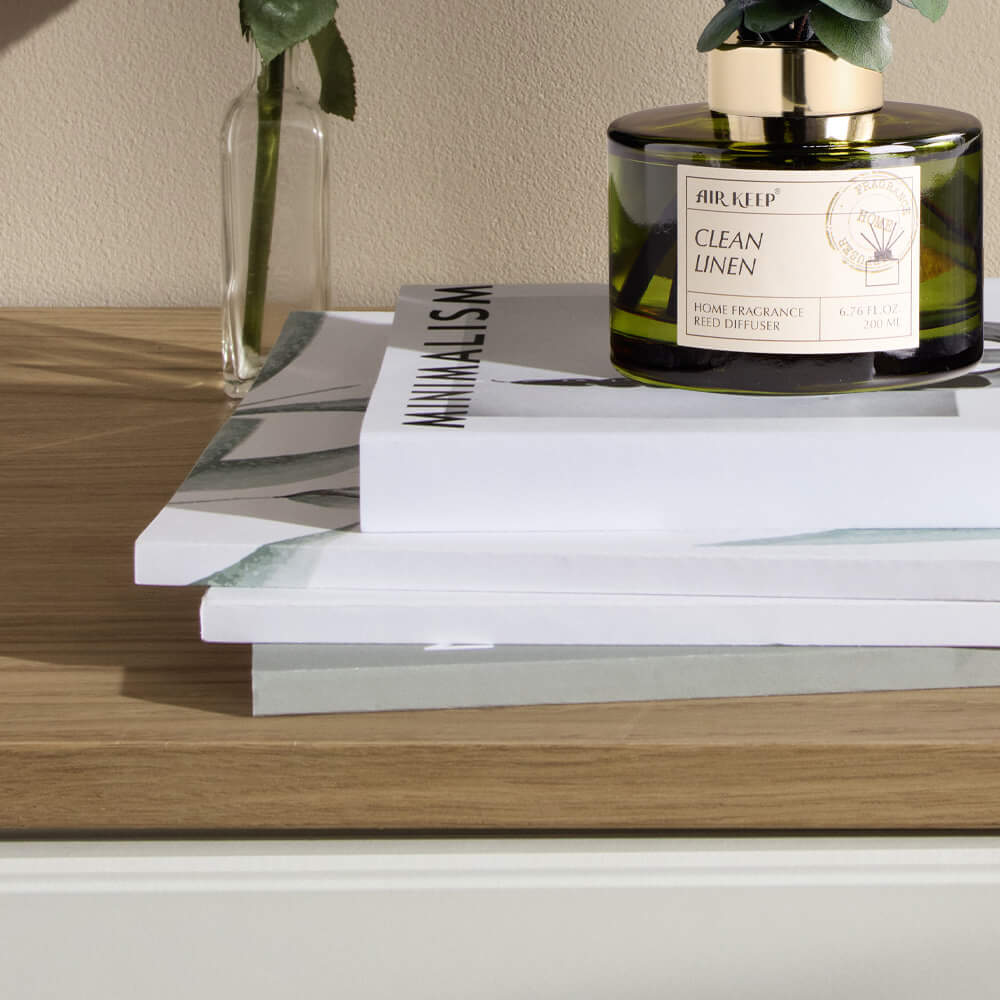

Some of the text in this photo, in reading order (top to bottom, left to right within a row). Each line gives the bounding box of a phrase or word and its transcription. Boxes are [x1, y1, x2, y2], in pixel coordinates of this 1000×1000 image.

[696, 189, 728, 207] AIR
[695, 228, 764, 250] CLEAN
[694, 254, 757, 276] LINEN
[694, 302, 804, 317] HOME FRAGRANCE
[694, 317, 780, 331] REED DIFFUSER
[863, 319, 884, 329] 200
[401, 285, 493, 428] MINIMALISM
